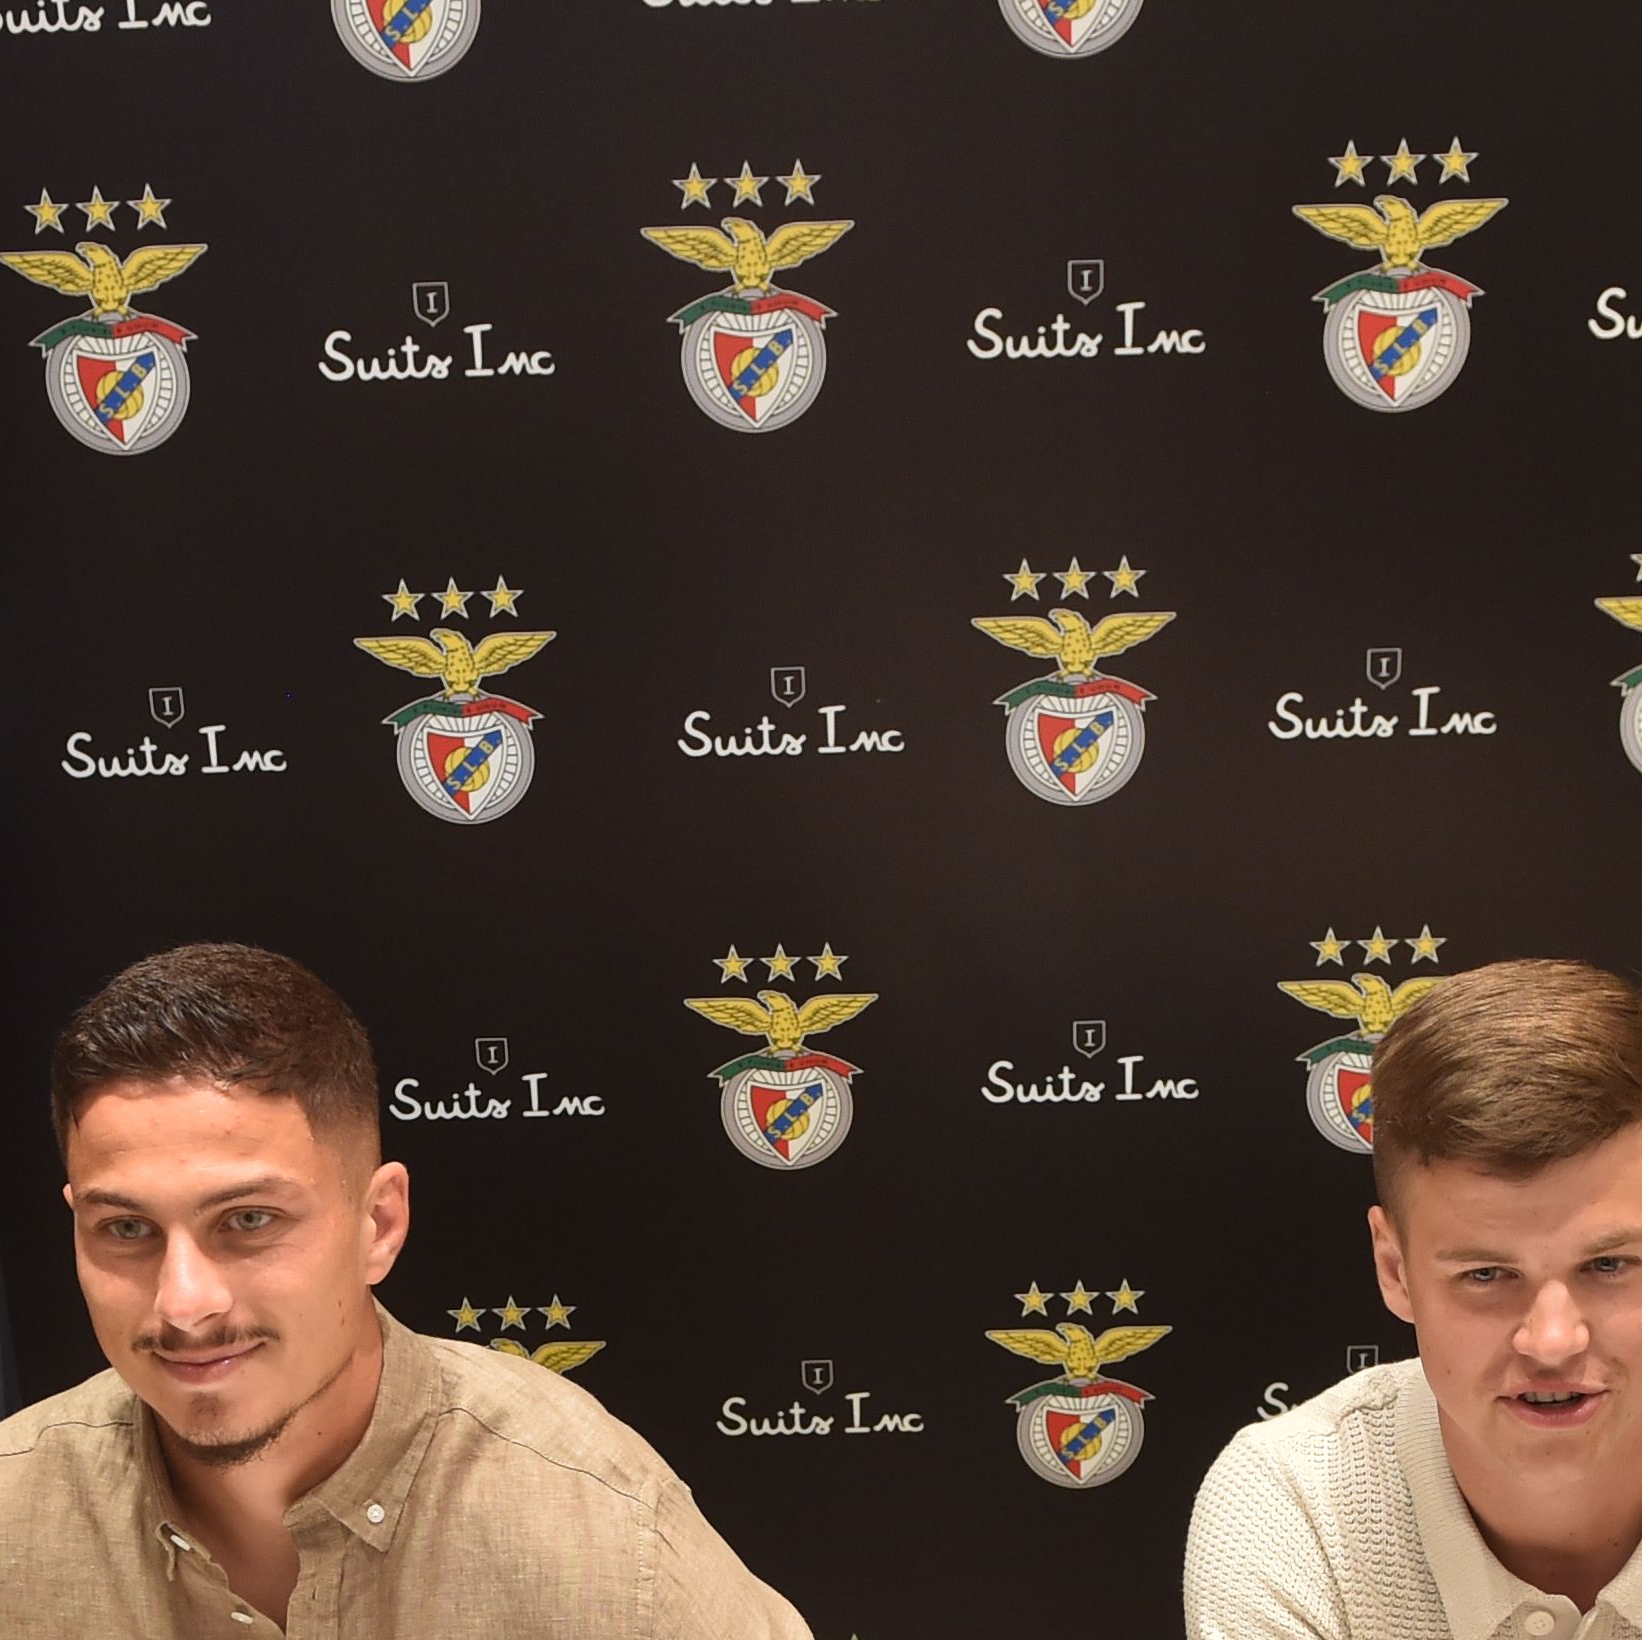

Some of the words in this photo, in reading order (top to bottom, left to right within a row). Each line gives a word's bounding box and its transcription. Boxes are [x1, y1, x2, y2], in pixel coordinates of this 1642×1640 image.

[319, 330, 452, 381] Suits
[464, 324, 555, 376] Inc
[967, 307, 1102, 358] Suits
[1114, 302, 1205, 355] Inc
[678, 711, 806, 756] Suits
[818, 705, 904, 753] Inc
[1269, 692, 1398, 738] Suits
[1409, 687, 1496, 735] Inc
[62, 732, 189, 777] Suits
[199, 725, 286, 773] Inc
[389, 1077, 511, 1120] Suits
[522, 1073, 605, 1116] Inc
[981, 1059, 1105, 1102] Suits
[1116, 1056, 1199, 1100] Inc
[717, 1397, 834, 1435] Suits
[845, 1392, 924, 1433] Inc
